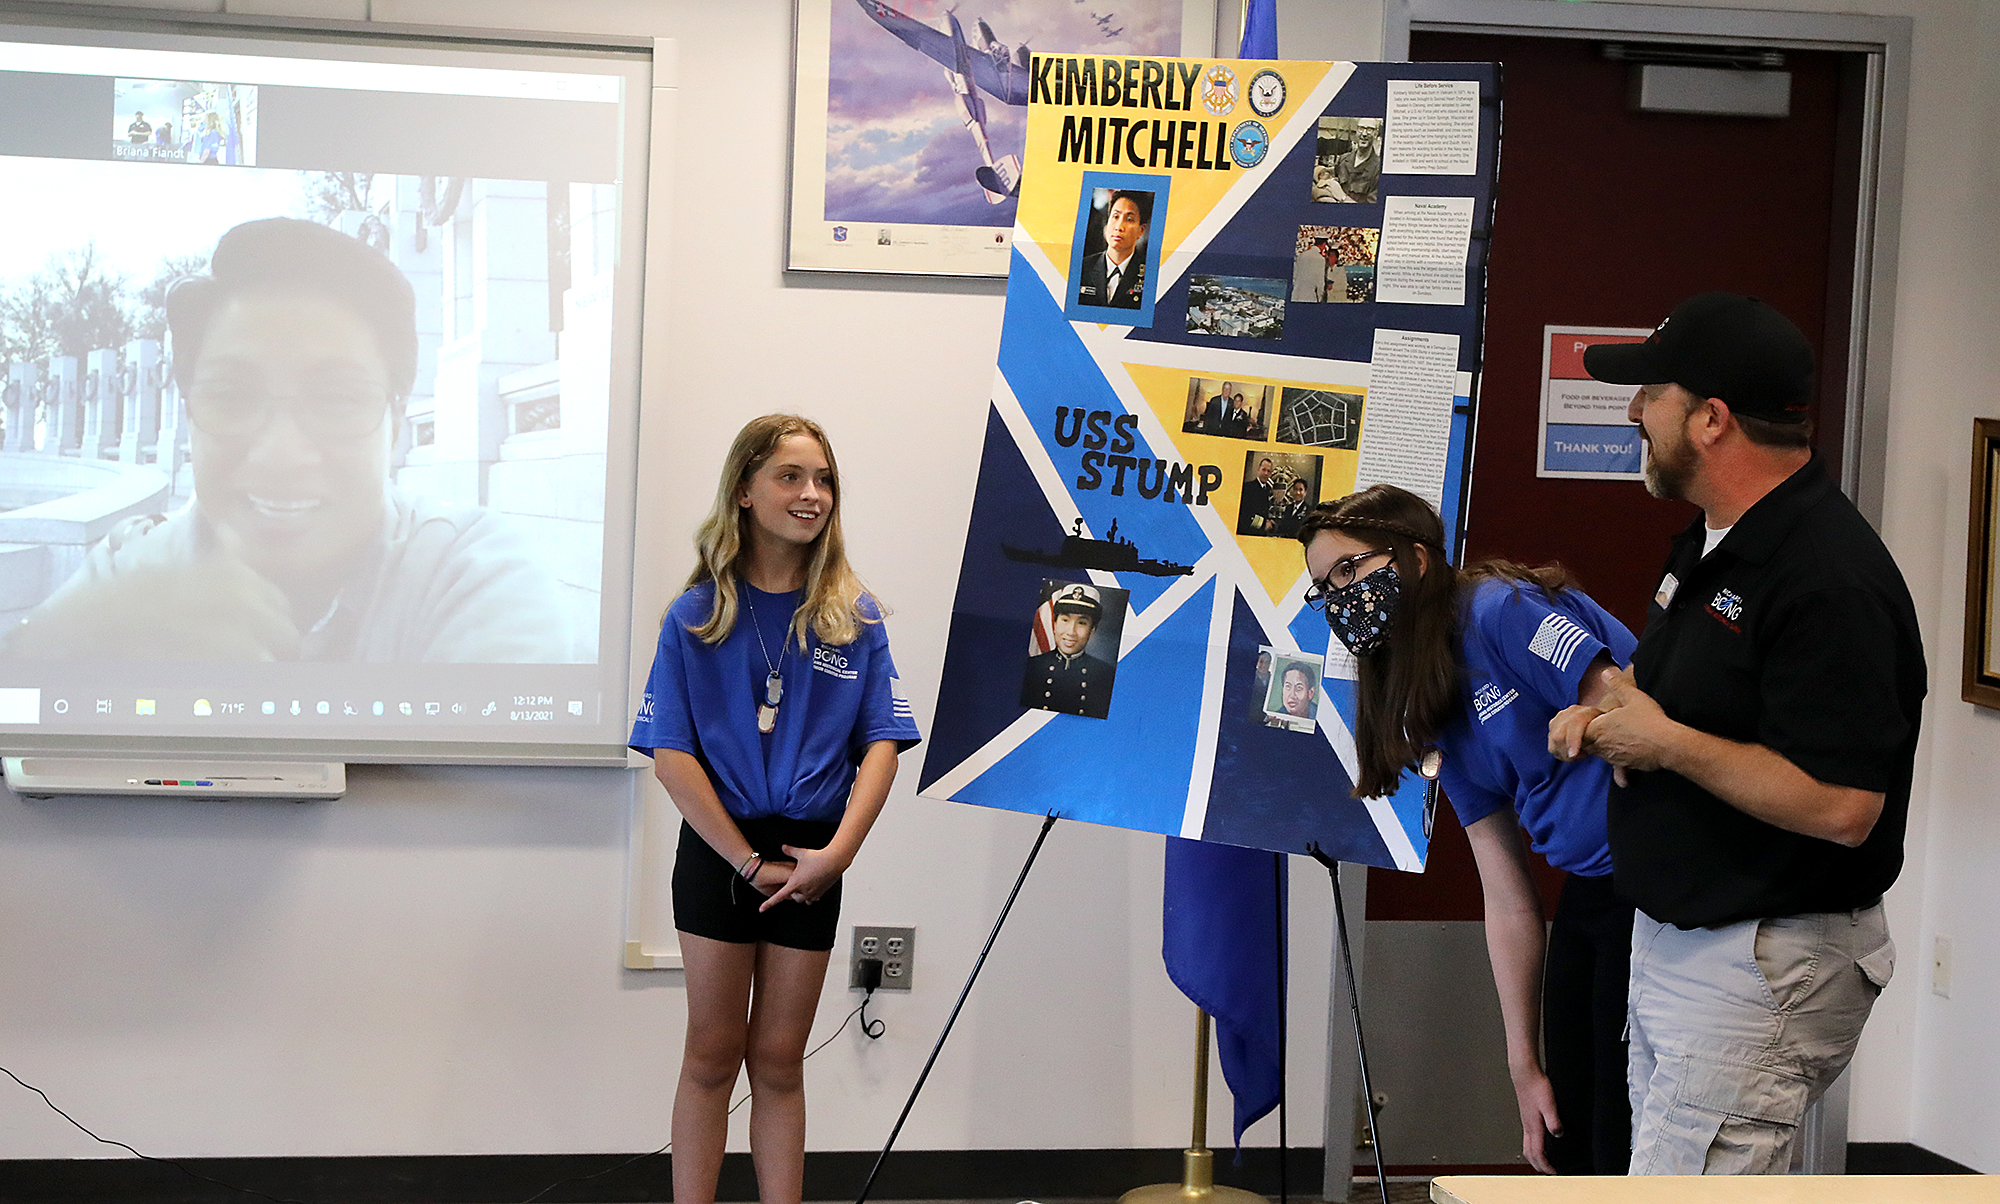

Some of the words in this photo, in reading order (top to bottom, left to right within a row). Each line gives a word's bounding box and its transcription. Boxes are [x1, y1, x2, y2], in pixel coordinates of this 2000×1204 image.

[1030, 56, 1203, 111] KIMBERLY
[116, 145, 149, 157] Briana
[1058, 115, 1232, 171] MITCHELL
[1561, 393, 1580, 401] FOOD
[1054, 406, 1138, 455] USS
[1554, 441, 1600, 454] THANK
[1603, 443, 1633, 455] YOU!
[1077, 451, 1223, 506] STUMP
[1711, 592, 1743, 621] BONG
[813, 647, 849, 669] BONG
[220, 702, 245, 714] 71°F
[513, 696, 536, 706] 12:12
[537, 696, 554, 706] PM
[1473, 685, 1502, 712] BONG
[510, 711, 554, 721] 8/13/2021
